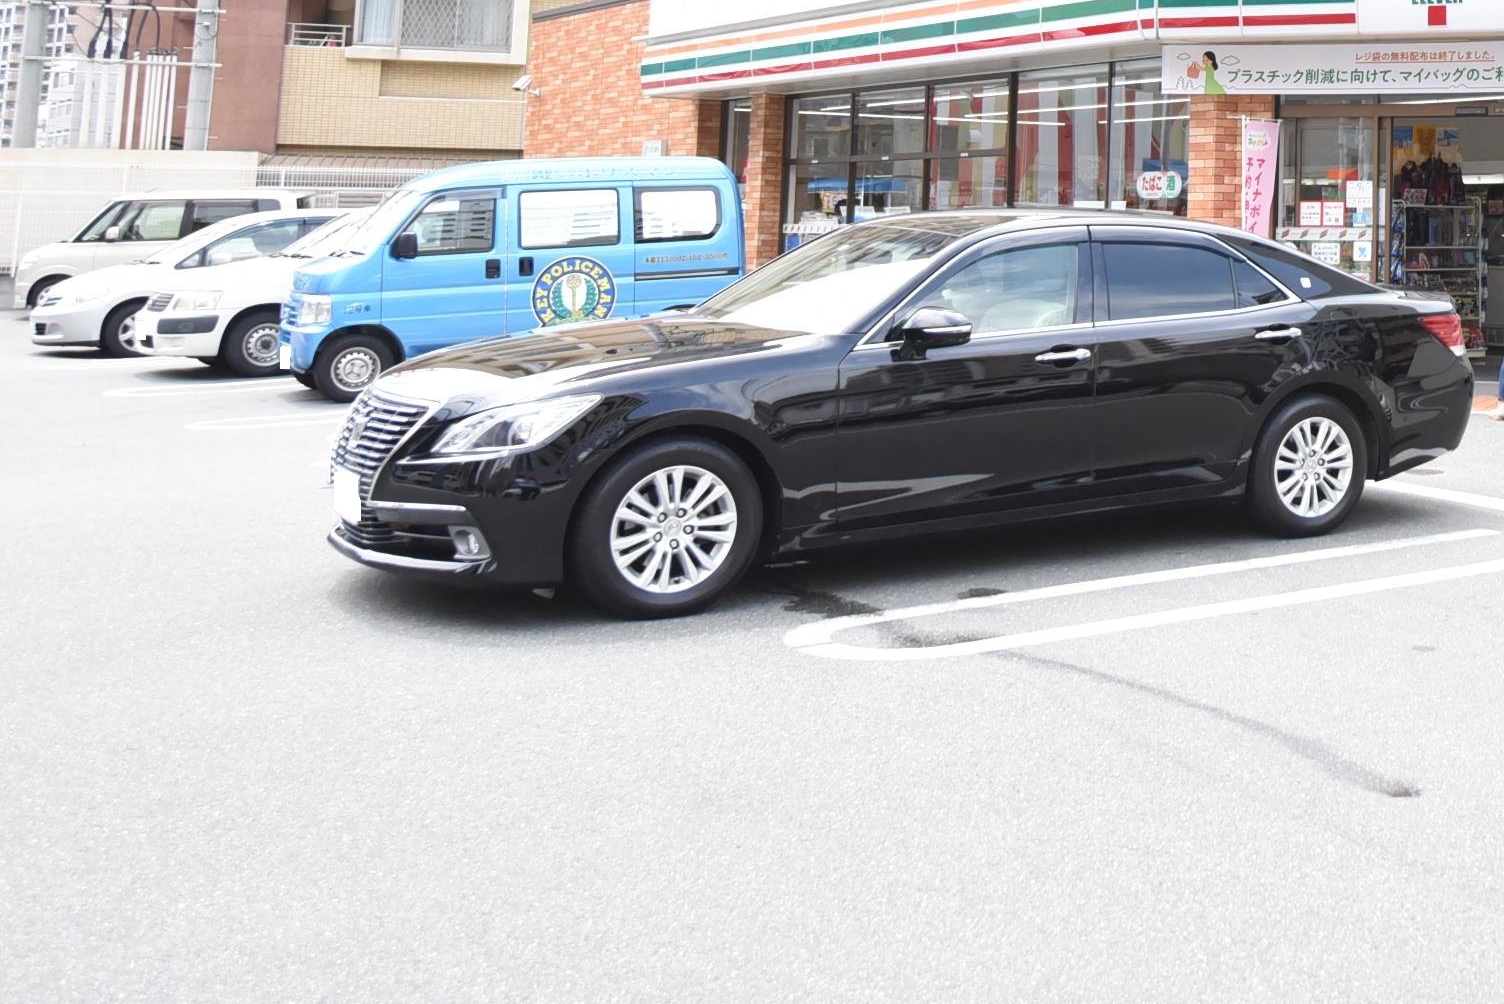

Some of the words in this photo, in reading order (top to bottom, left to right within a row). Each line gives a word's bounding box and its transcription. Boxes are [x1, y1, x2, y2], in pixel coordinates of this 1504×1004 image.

[1355, 50, 1496, 62] レジ袋の無料配布は終了しました。
[1142, 176, 1162, 191] たばこ
[1165, 176, 1176, 191] 酒
[541, 259, 612, 319] POLICEMAN
[536, 287, 555, 323] KEY
